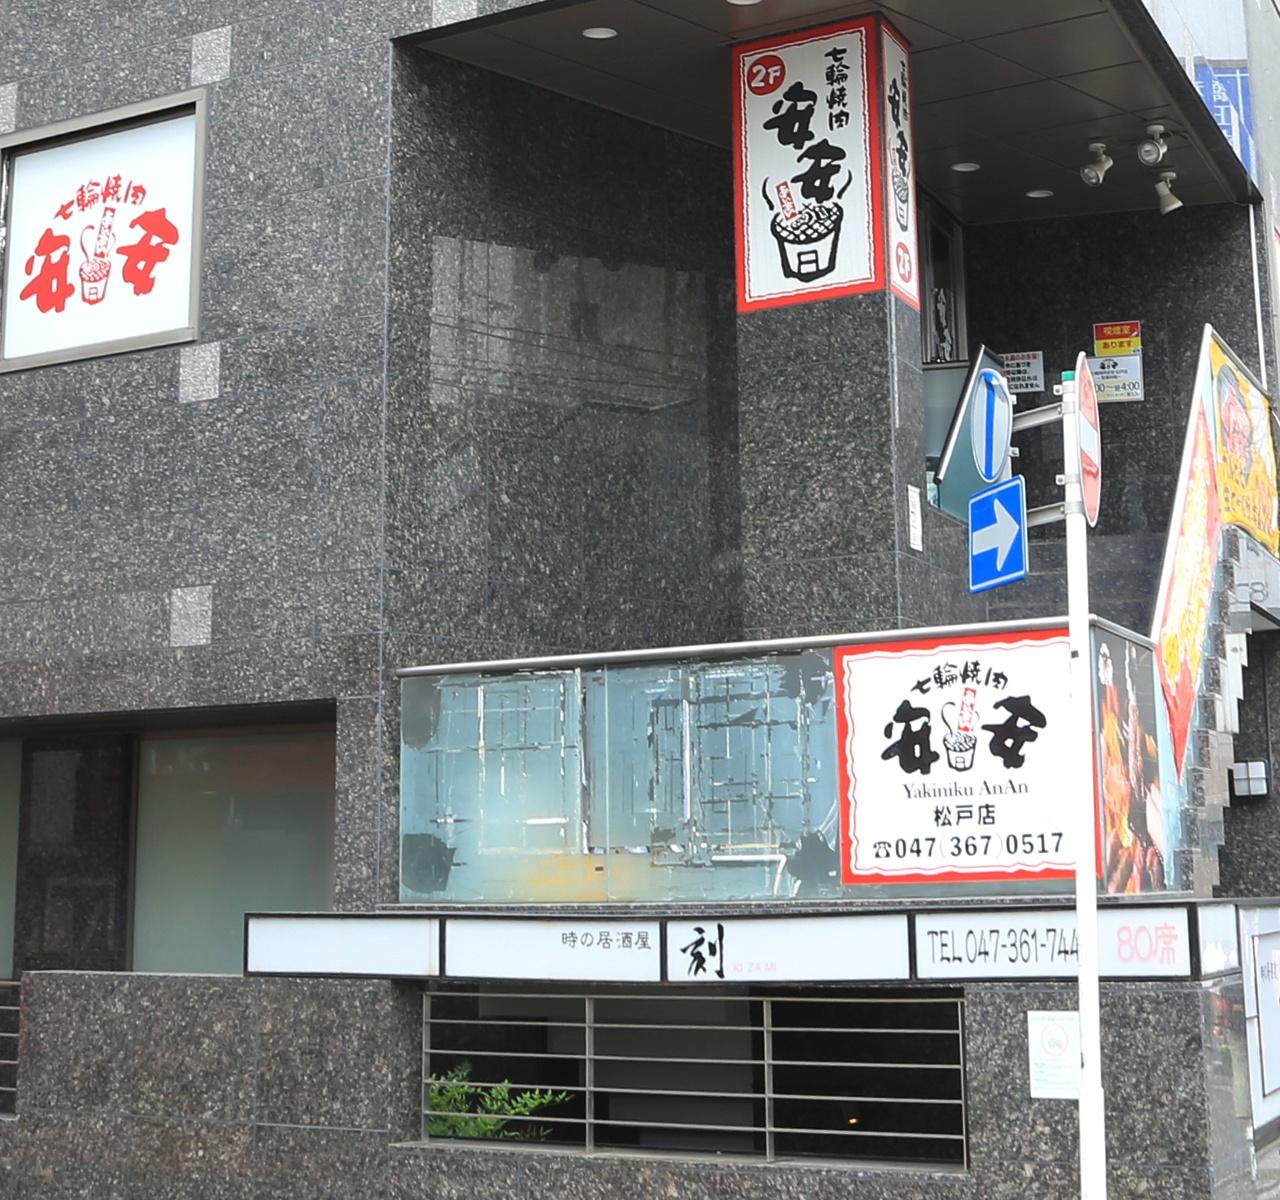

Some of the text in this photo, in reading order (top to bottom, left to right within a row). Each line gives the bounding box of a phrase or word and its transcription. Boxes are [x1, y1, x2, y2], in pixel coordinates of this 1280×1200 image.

[750, 63, 782, 89] 2F
[823, 47, 851, 132] 七輪焼肉
[54, 173, 147, 221] 七輪焼肉
[911, 659, 1009, 696] 七輪焼肉
[902, 781, 974, 800] Yakiniku
[933, 803, 997, 828] 松戸店
[560, 930, 652, 951] 時の居酒屋
[678, 922, 726, 981] 刻
[927, 927, 1081, 965] TEL 047-361-744
[1117, 924, 1179, 966] 80席
